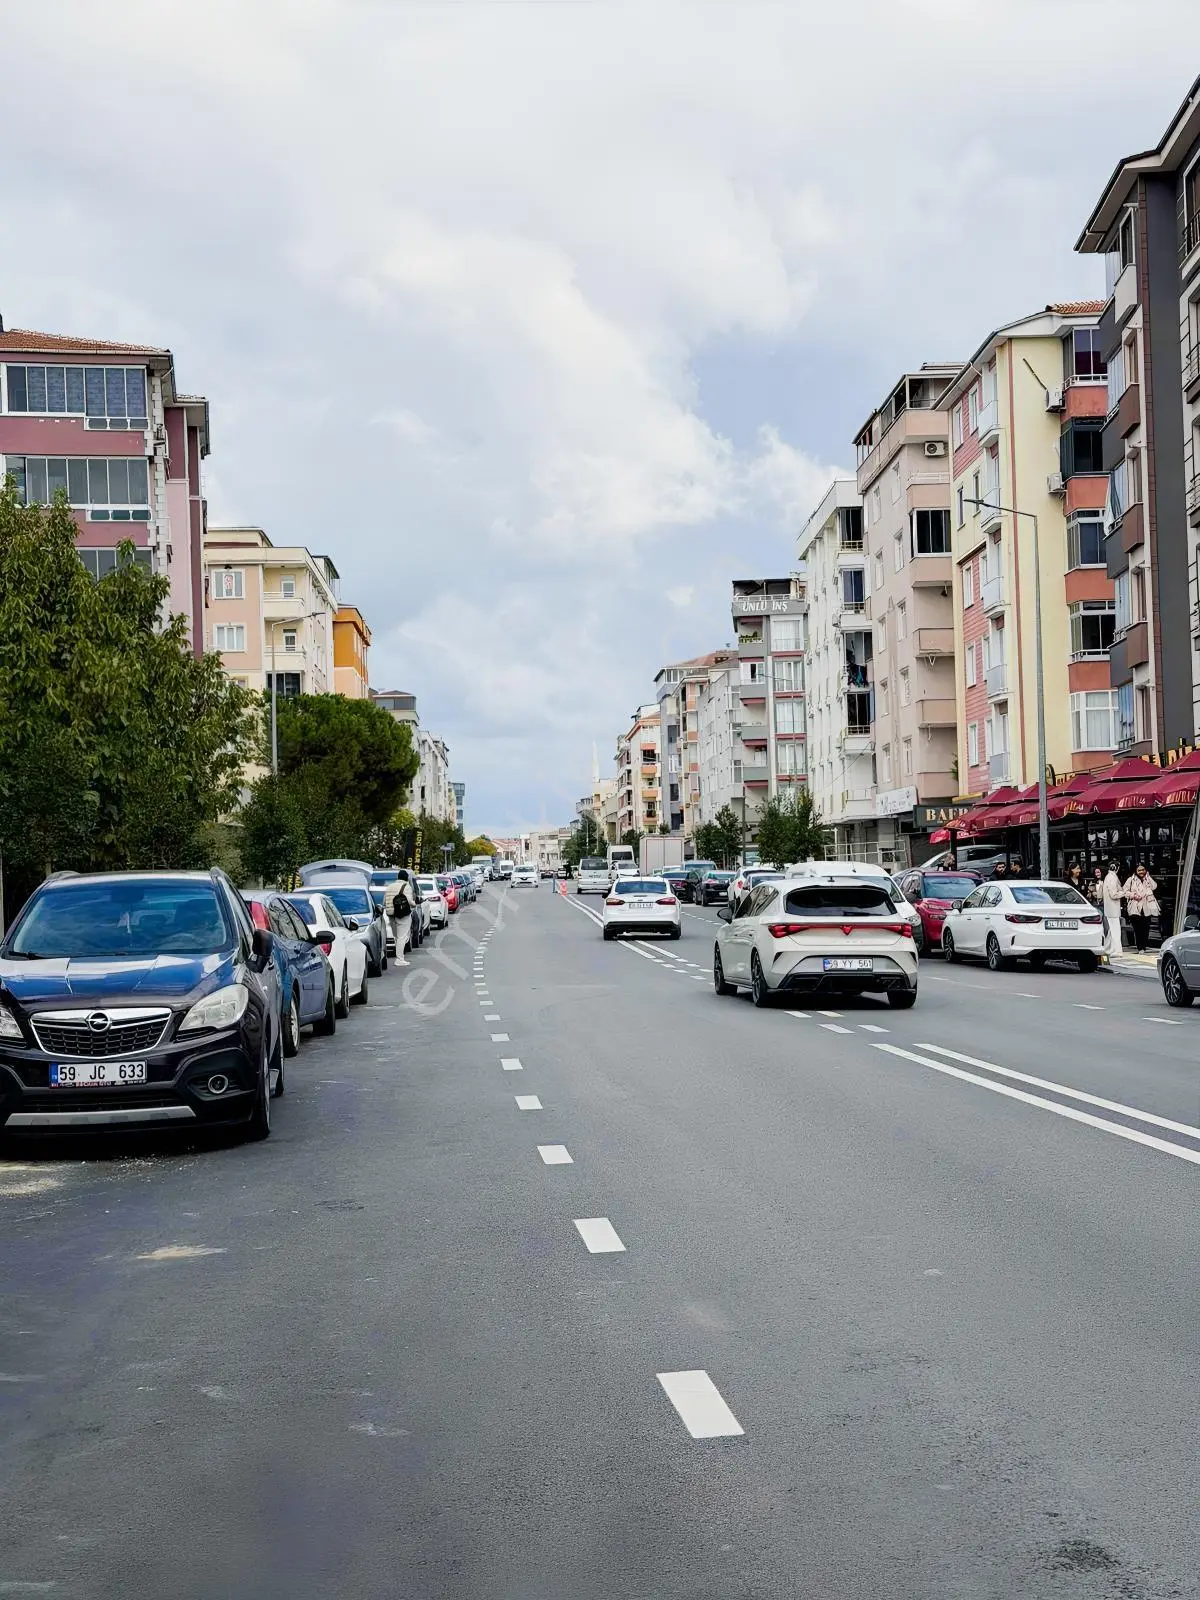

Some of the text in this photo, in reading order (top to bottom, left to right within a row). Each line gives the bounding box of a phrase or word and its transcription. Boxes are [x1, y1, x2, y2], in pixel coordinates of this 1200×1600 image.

[59, 1063, 144, 1081] 59 JC 633
